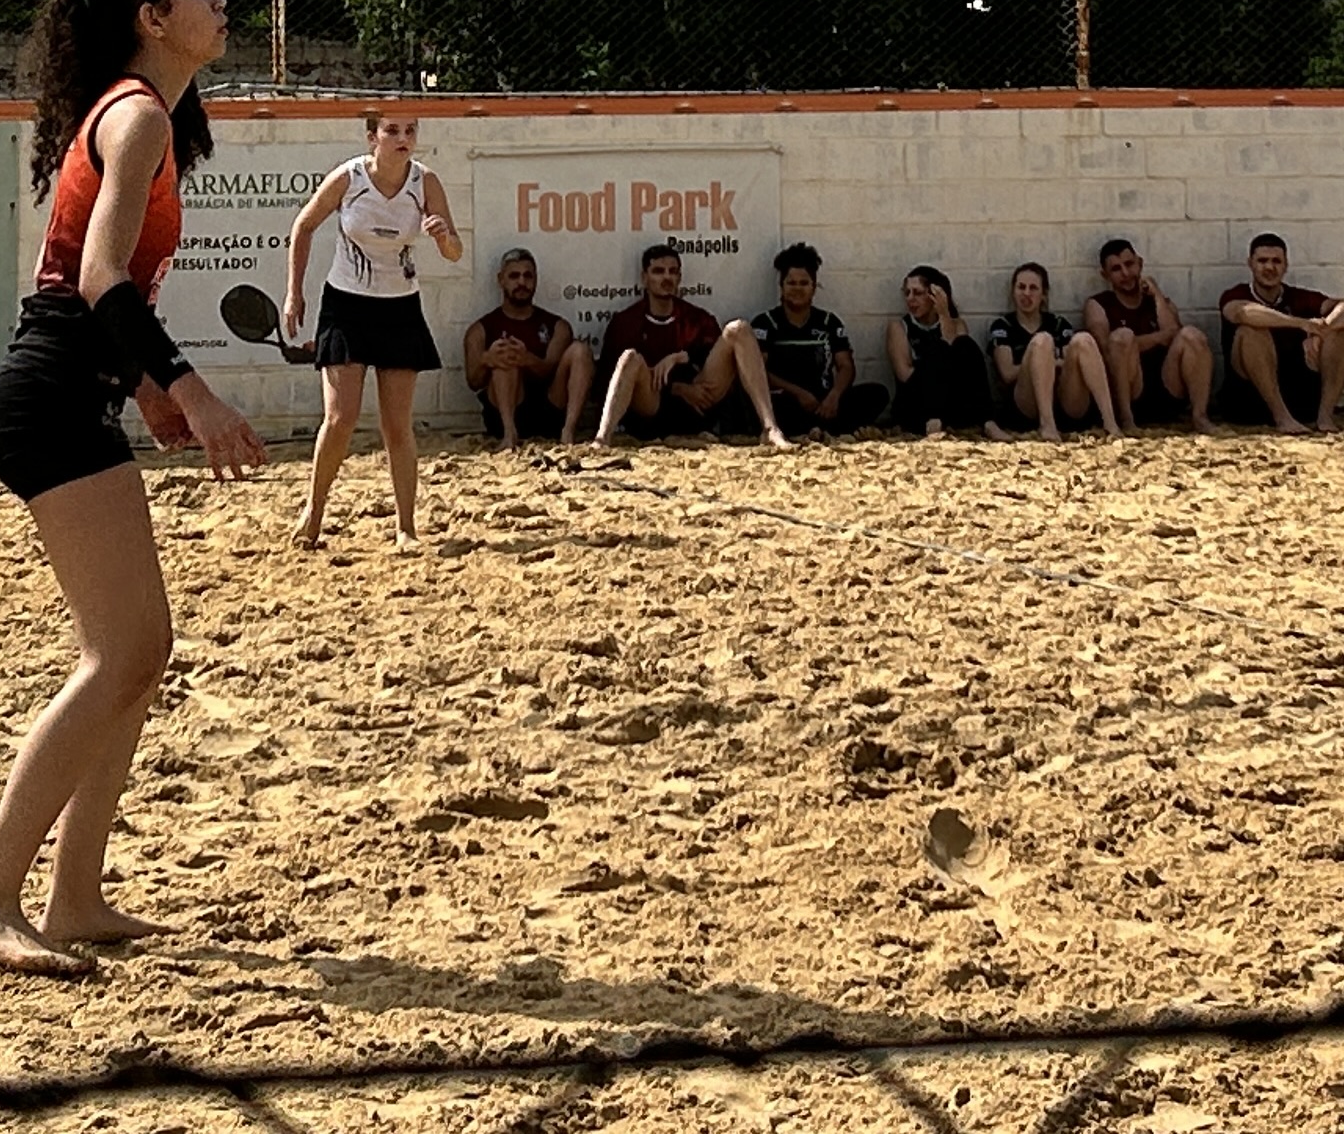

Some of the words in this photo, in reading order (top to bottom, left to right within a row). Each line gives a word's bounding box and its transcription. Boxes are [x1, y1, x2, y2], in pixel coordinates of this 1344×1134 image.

[182, 173, 324, 196] ARMAFLOR
[517, 181, 616, 233] Food
[630, 181, 738, 232] Park
[268, 236, 280, 249] O
